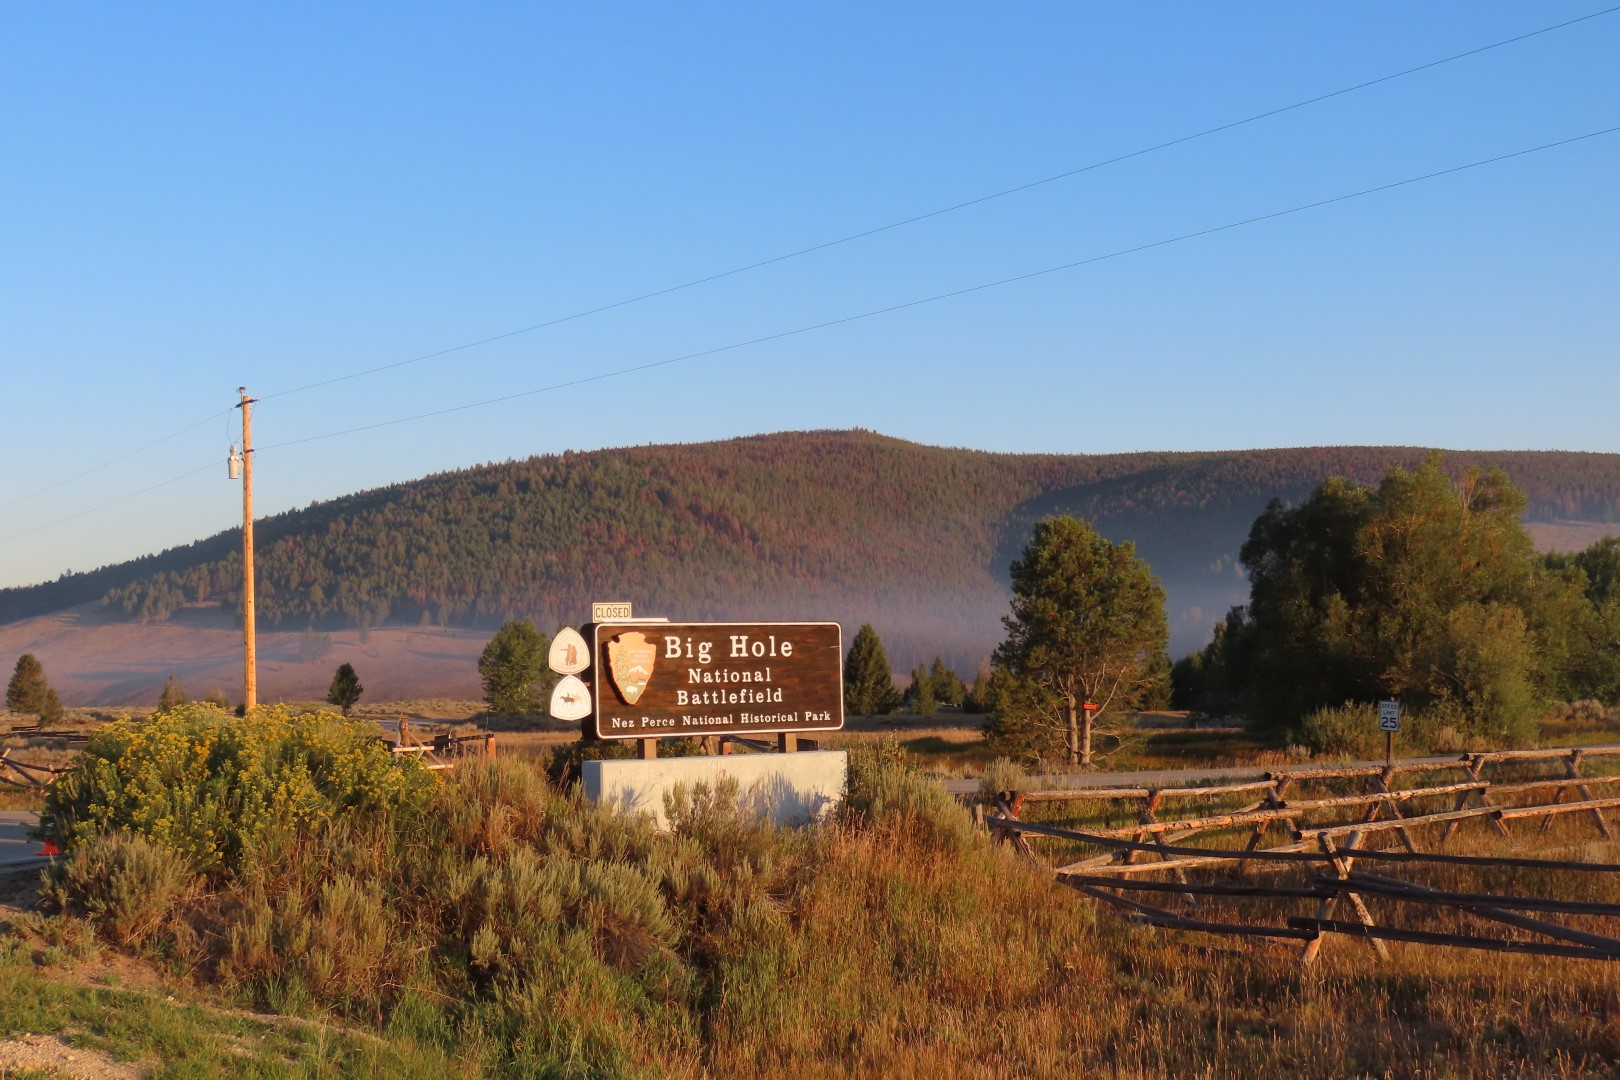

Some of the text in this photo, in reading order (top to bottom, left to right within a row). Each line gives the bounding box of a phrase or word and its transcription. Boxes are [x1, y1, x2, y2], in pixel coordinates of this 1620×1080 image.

[595, 606, 630, 619] CLOSED
[664, 635, 794, 664] Big Hole
[688, 667, 772, 684] National
[677, 687, 783, 706] Battlefield
[611, 710, 831, 729] Nez Perce National Historical Park
[1381, 716, 1397, 728] 25
